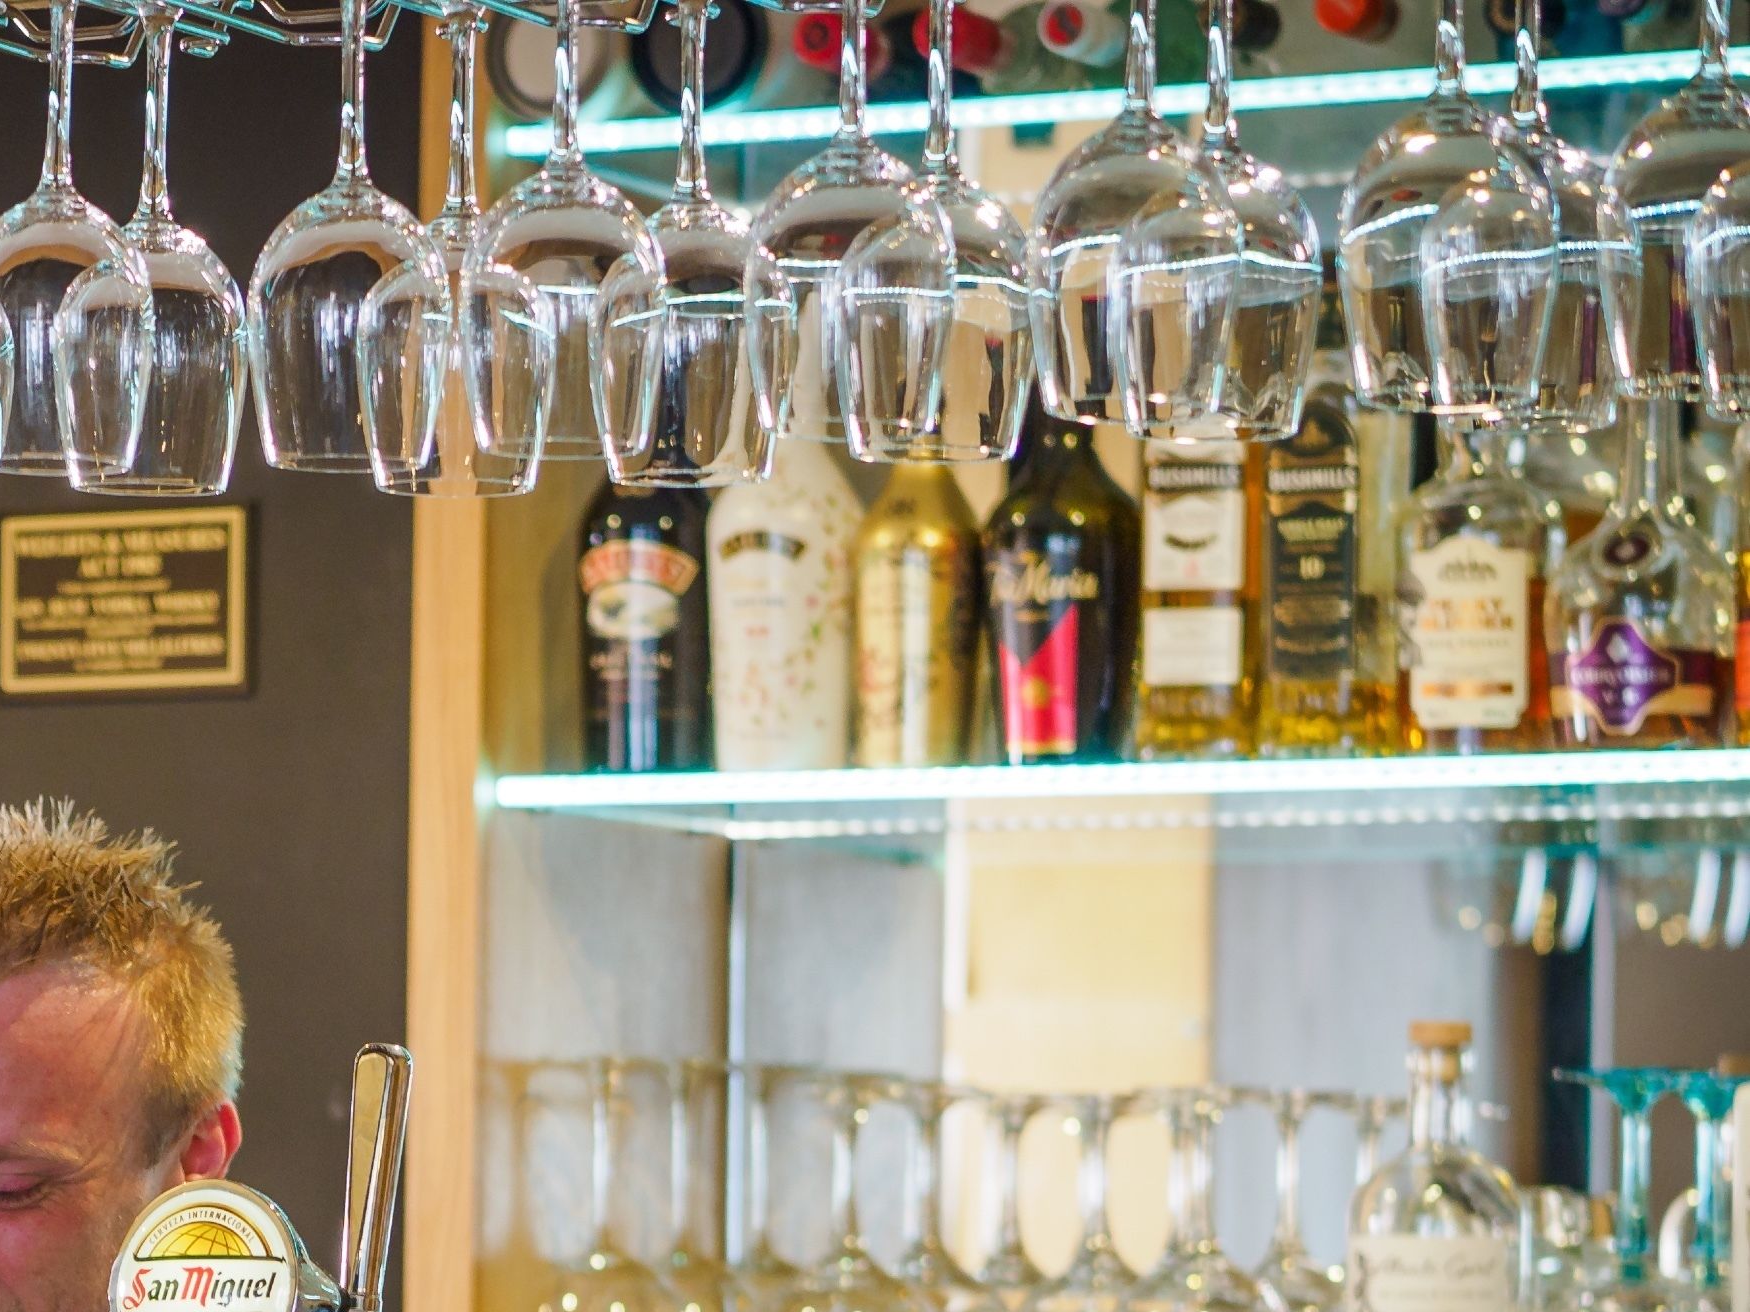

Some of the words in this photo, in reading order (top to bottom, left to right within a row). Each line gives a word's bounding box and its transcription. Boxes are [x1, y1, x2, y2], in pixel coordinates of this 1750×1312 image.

[148, 1215, 185, 1245] CERVEZA
[188, 1210, 255, 1242] INTERNACIONAL
[122, 1266, 180, 1310] San
[181, 1266, 277, 1307] Miguel
